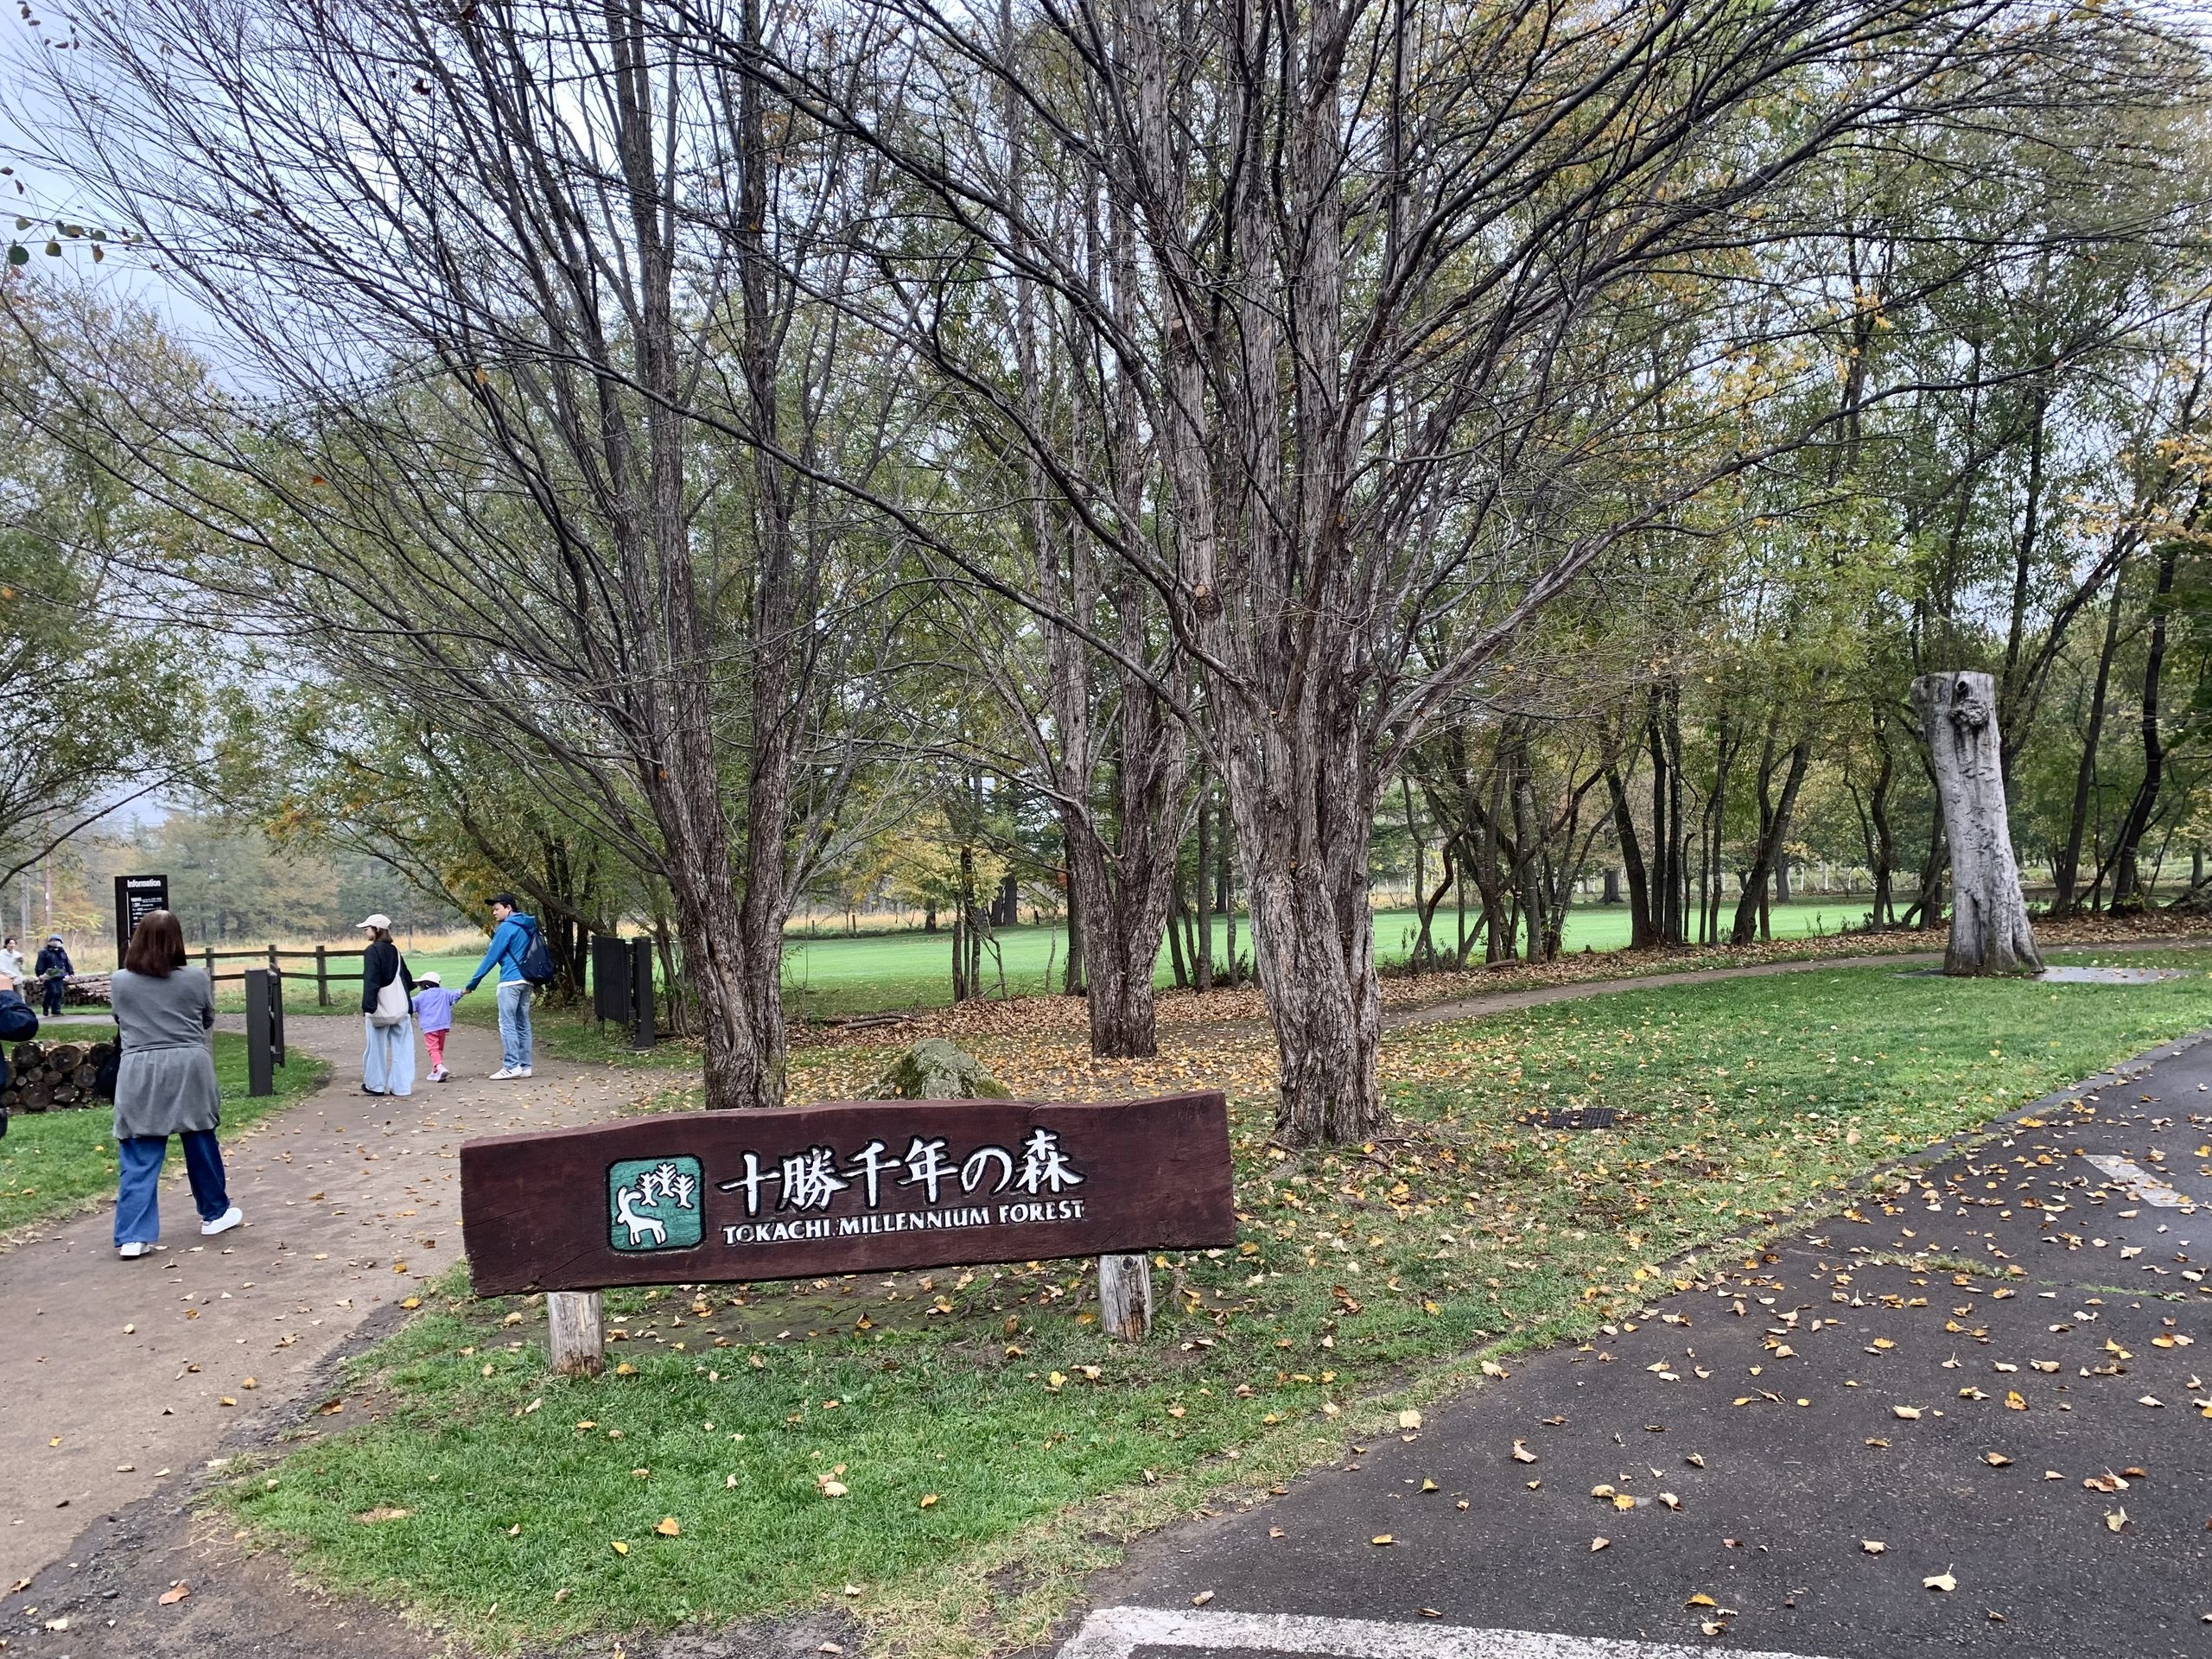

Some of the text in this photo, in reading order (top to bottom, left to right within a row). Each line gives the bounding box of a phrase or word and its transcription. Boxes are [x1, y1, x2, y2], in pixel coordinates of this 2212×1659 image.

[127, 879, 162, 888] Information
[717, 1128, 1085, 1215] 十勝千年の森
[722, 1200, 1084, 1244] TOKACHI MILLENNIUM FOREST
